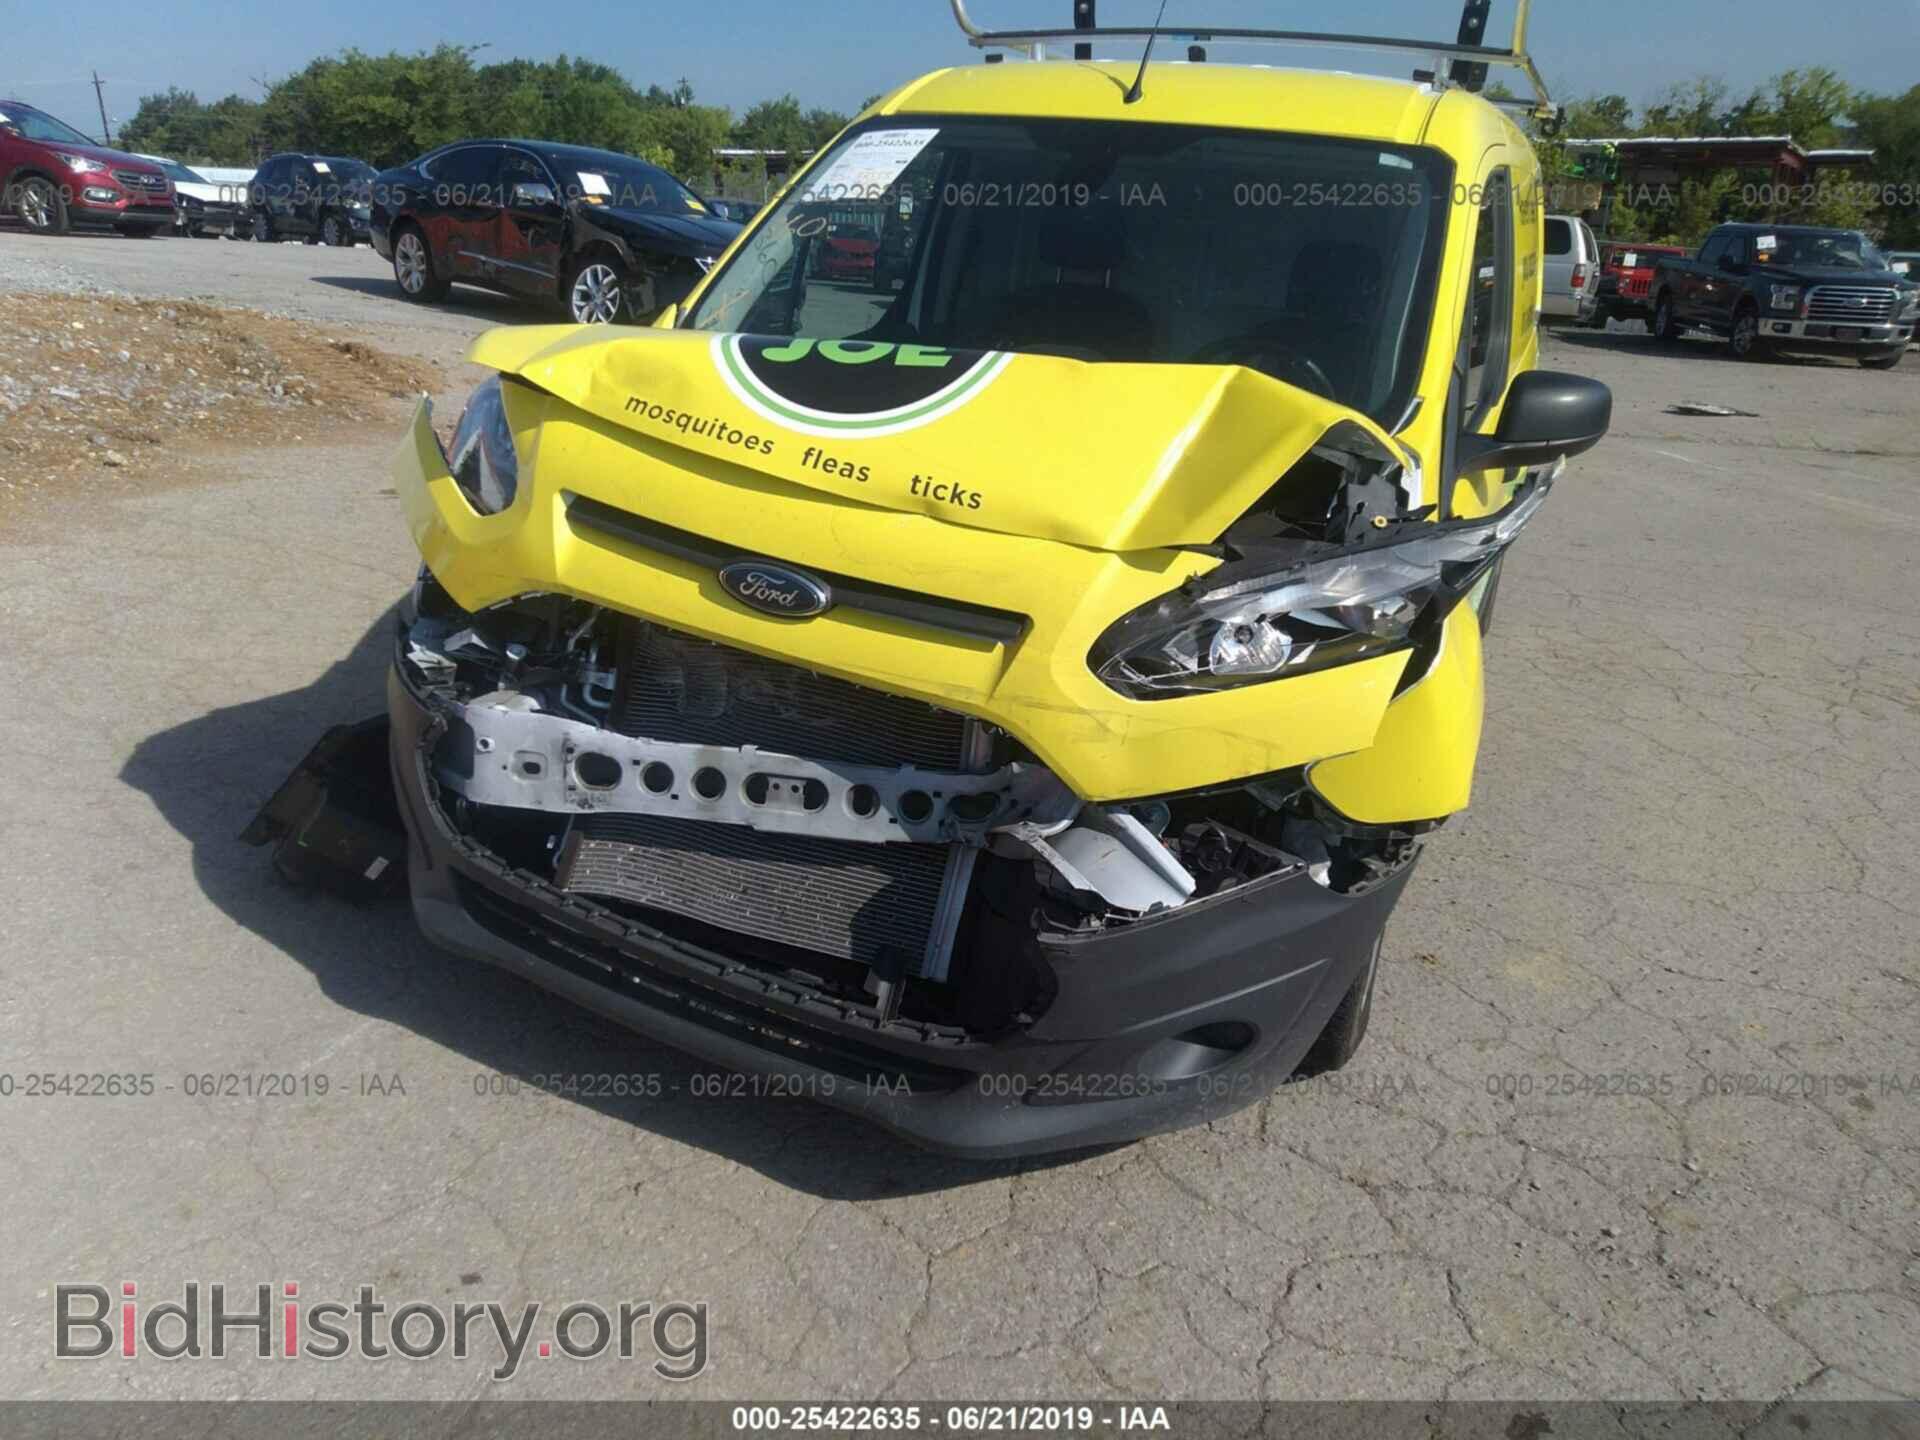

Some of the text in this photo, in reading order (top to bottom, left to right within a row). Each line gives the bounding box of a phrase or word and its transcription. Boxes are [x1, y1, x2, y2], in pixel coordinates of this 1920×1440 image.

[762, 338, 952, 366] JOE
[624, 395, 983, 509] mosquitoes fleas ticks
[740, 571, 800, 606] Ford
